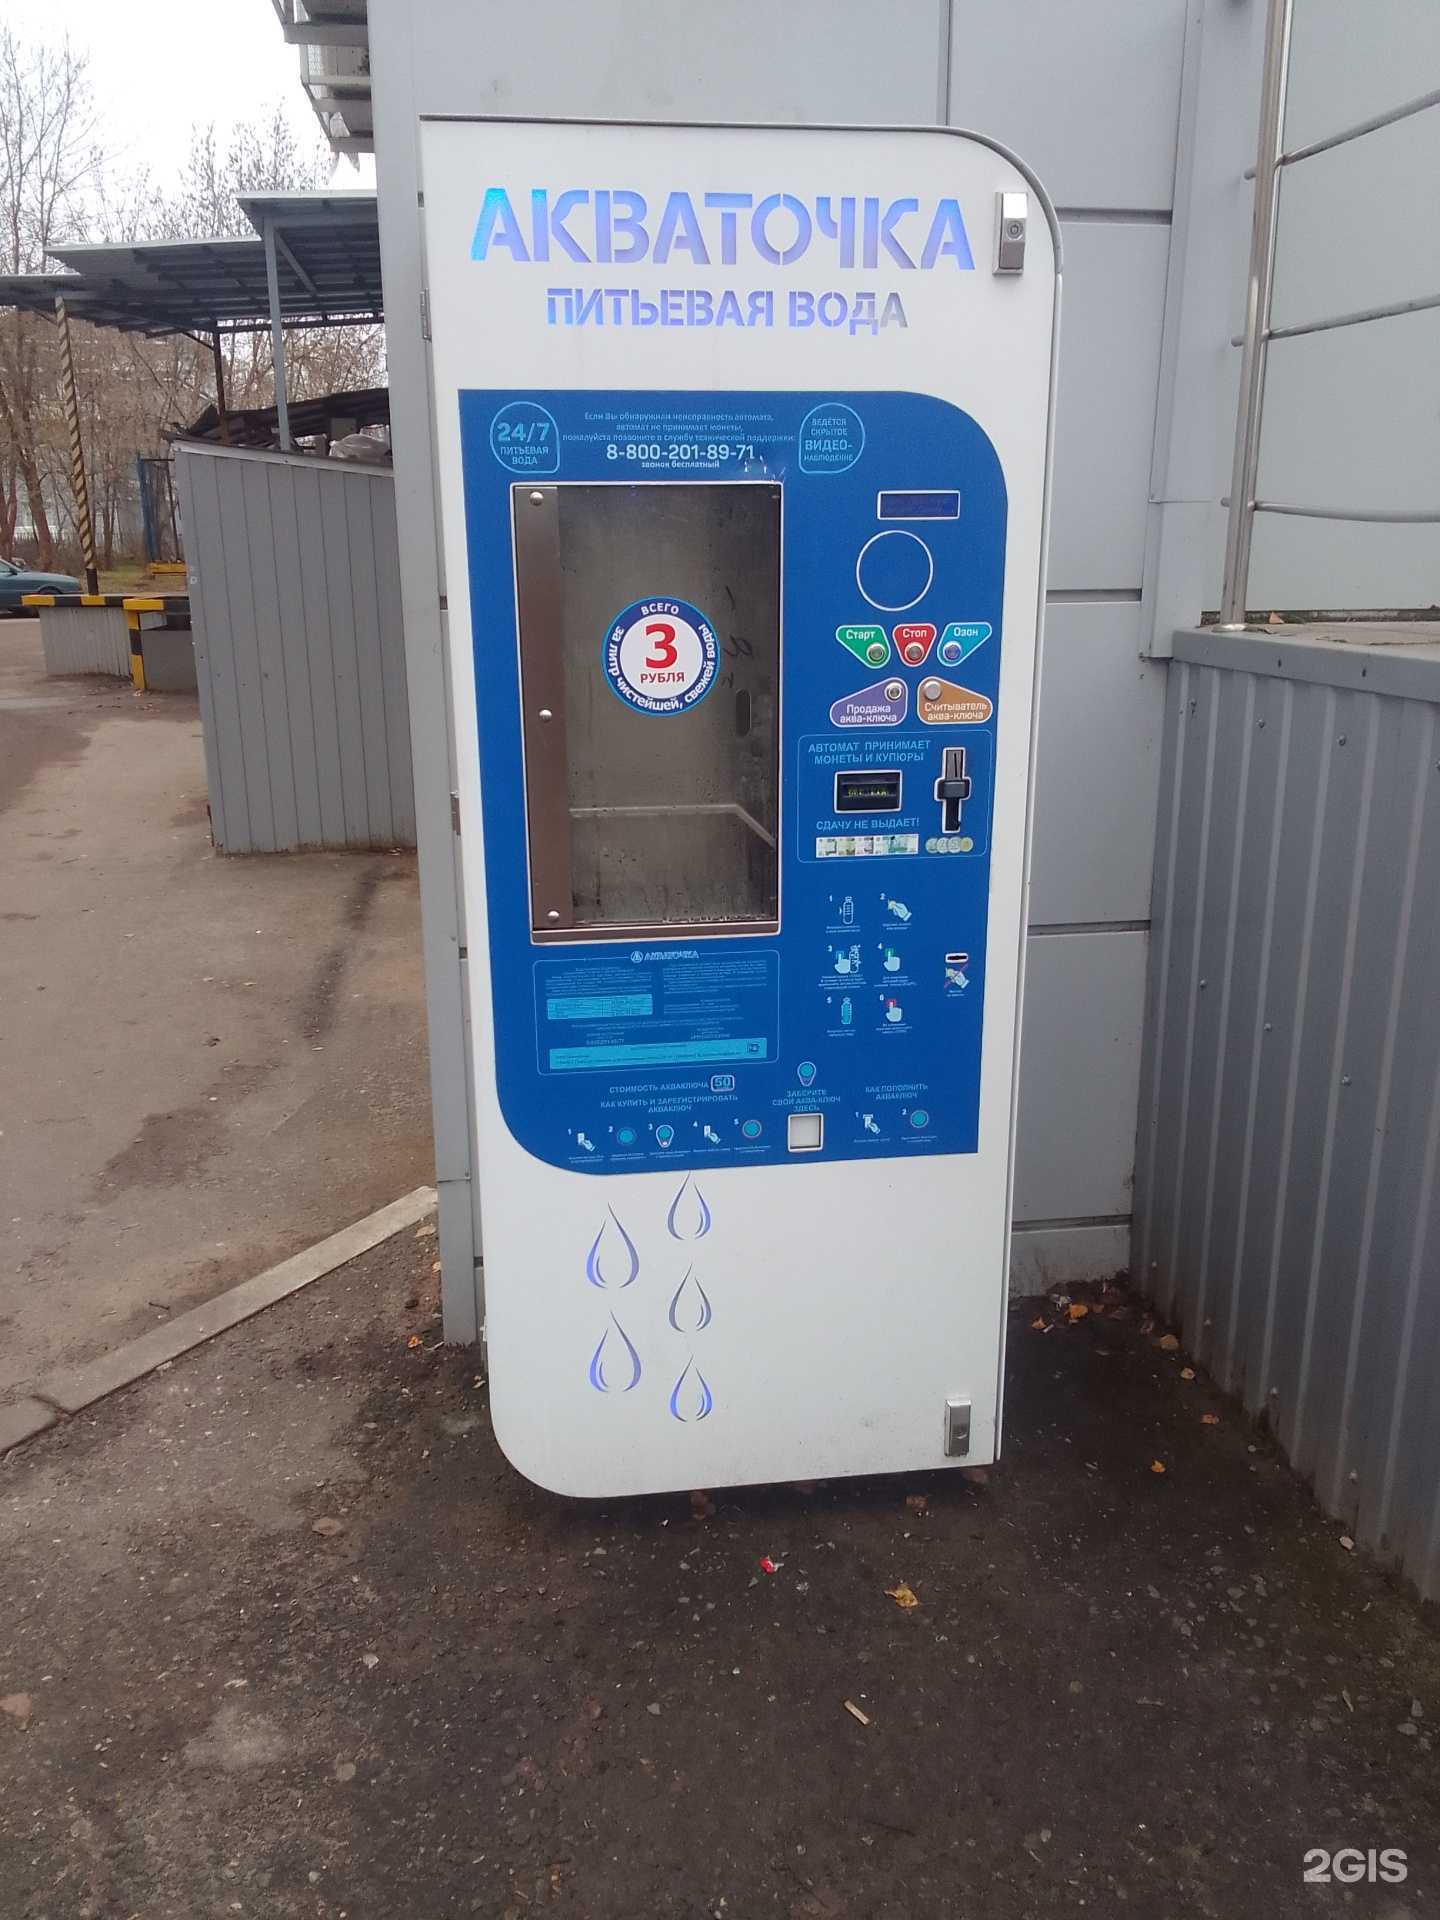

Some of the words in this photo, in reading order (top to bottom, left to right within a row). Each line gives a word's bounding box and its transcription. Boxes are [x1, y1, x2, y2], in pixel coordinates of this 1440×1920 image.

[470, 187, 976, 270] АКВАТОЧКА
[547, 288, 774, 327] ПИТЬЕВАЯ
[788, 291, 908, 336] ВОДА
[497, 422, 550, 443] 24/7
[811, 428, 848, 436] СКРЫТОЕ
[500, 446, 549, 456] ПИТЬЕВАЯ
[606, 443, 755, 461] 8-800-201-89-71
[805, 439, 853, 453] ВИДЕО-
[512, 456, 538, 465] ВОДА
[671, 460, 721, 468] бесплатный
[641, 602, 679, 616] ВСЕГО
[846, 629, 876, 640] Старт
[902, 628, 927, 639] Стоп
[953, 627, 979, 637] Озон
[645, 623, 678, 669] 3
[698, 623, 716, 658] воды
[608, 643, 620, 677] литр
[640, 671, 685, 684] РУБЛЯ
[684, 660, 715, 703] свежей
[616, 677, 683, 711] чистейшей,
[846, 704, 891, 715] Продажа
[924, 702, 987, 712] Считыватель
[840, 714, 897, 723] аква-ключа
[927, 711, 984, 721] аква-ключа
[808, 742, 859, 753] АВТОМАТ
[864, 740, 931, 751] ПРИНИМАЕТ
[814, 754, 864, 765] МОНЕТЫ
[865, 754, 873, 763] И
[876, 752, 924, 763] КУПЮРЫ
[816, 820, 850, 831] СДАЧУ
[855, 819, 870, 829] НЕ
[872, 817, 920, 829] ВЫДАЕТ!
[609, 1084, 658, 1094] СТОИМОСТЬ
[600, 1100, 616, 1108] КАК
[617, 1098, 648, 1108] КУПИТЬ
[650, 1098, 656, 1106] И
